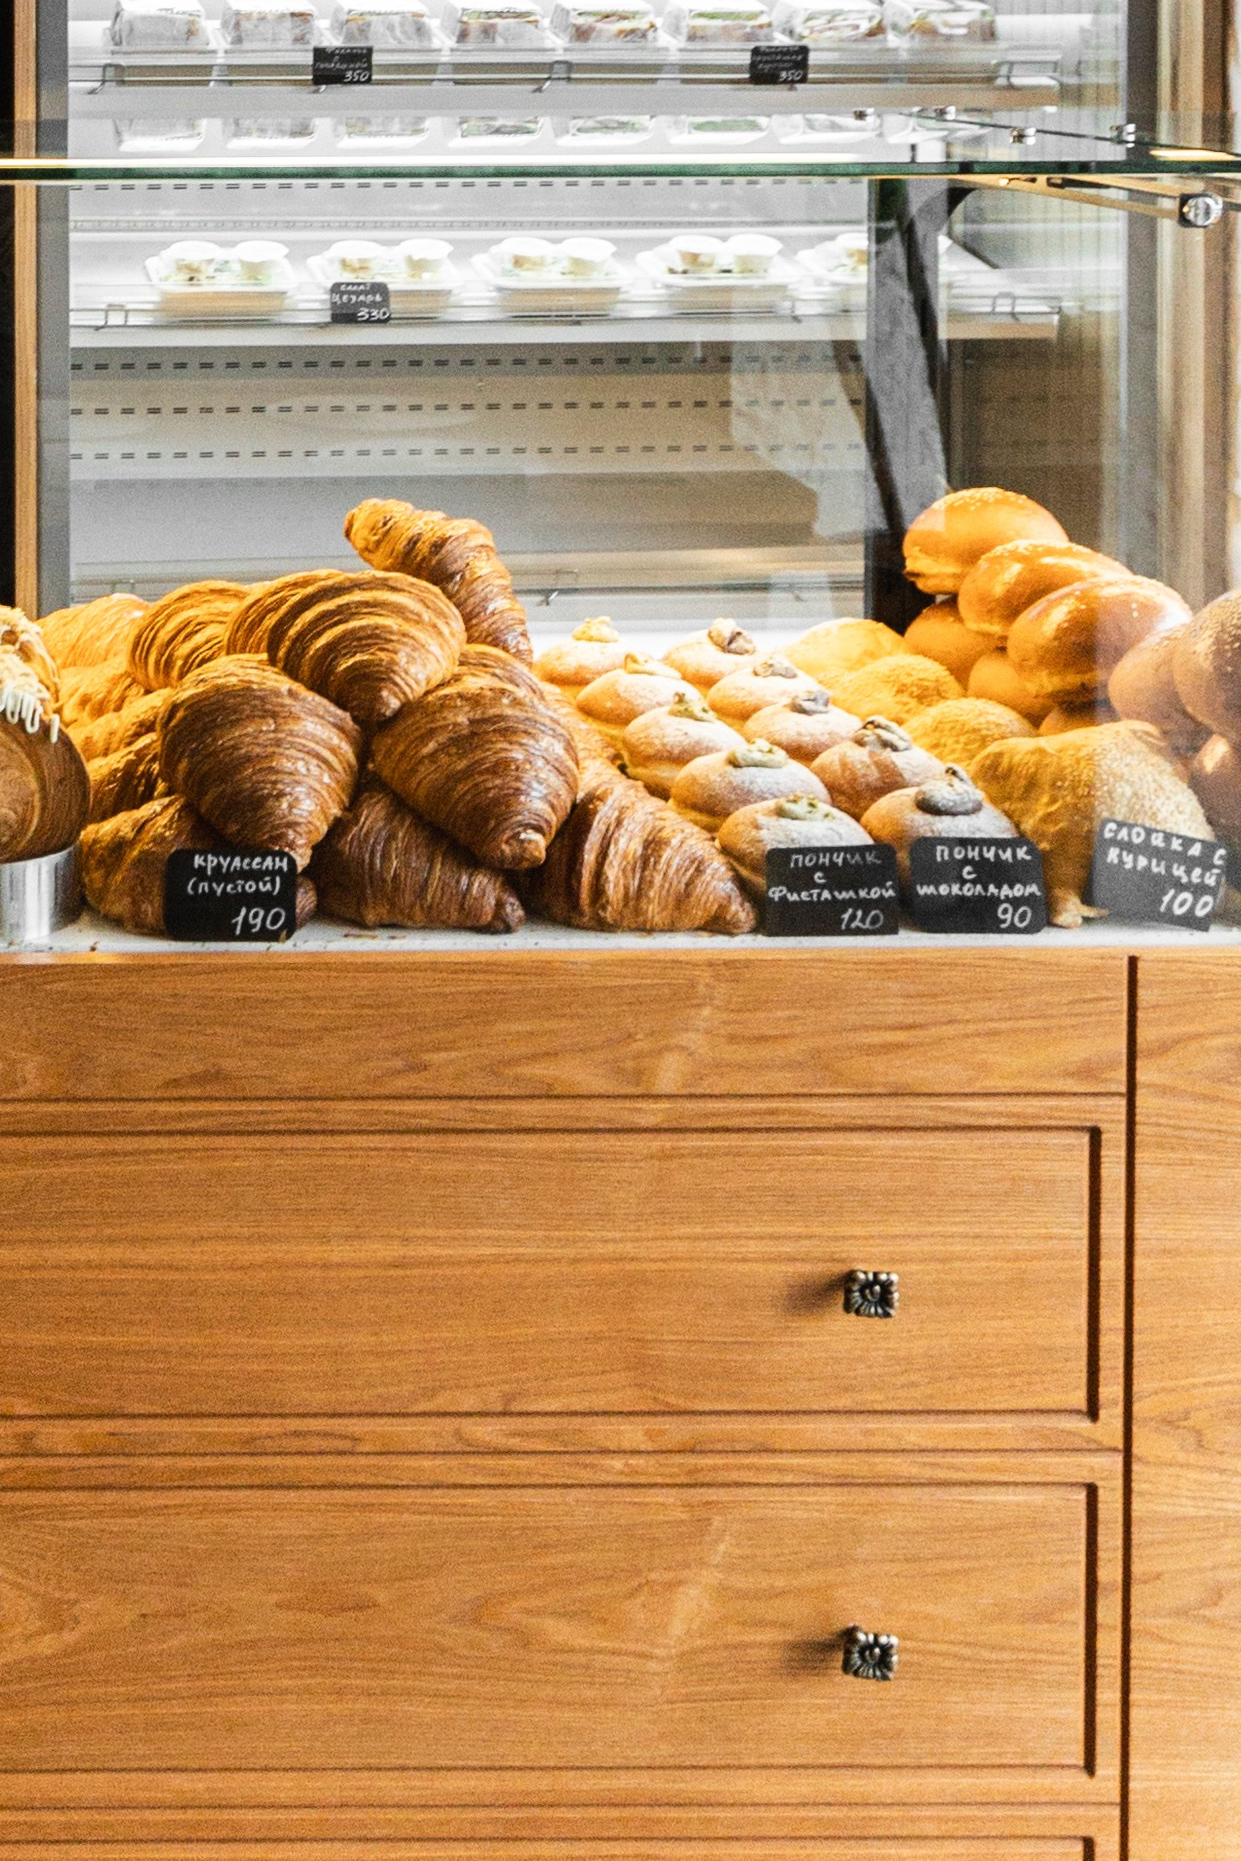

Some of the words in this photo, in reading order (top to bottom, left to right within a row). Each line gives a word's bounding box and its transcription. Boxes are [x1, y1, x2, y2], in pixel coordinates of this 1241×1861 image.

[343, 70, 370, 82] 350
[779, 70, 804, 82] 350
[357, 307, 390, 321] 330
[790, 850, 882, 868] ПОНЧИК
[936, 845, 1032, 863] ПОНЧИК
[1106, 846, 1222, 887] КУРИЦЕЙ
[916, 882, 1042, 900] ШОКОЛАДОМ
[1160, 888, 1214, 917] 100
[231, 906, 286, 936] 190
[841, 907, 884, 930] 120
[997, 902, 1032, 928] 90
